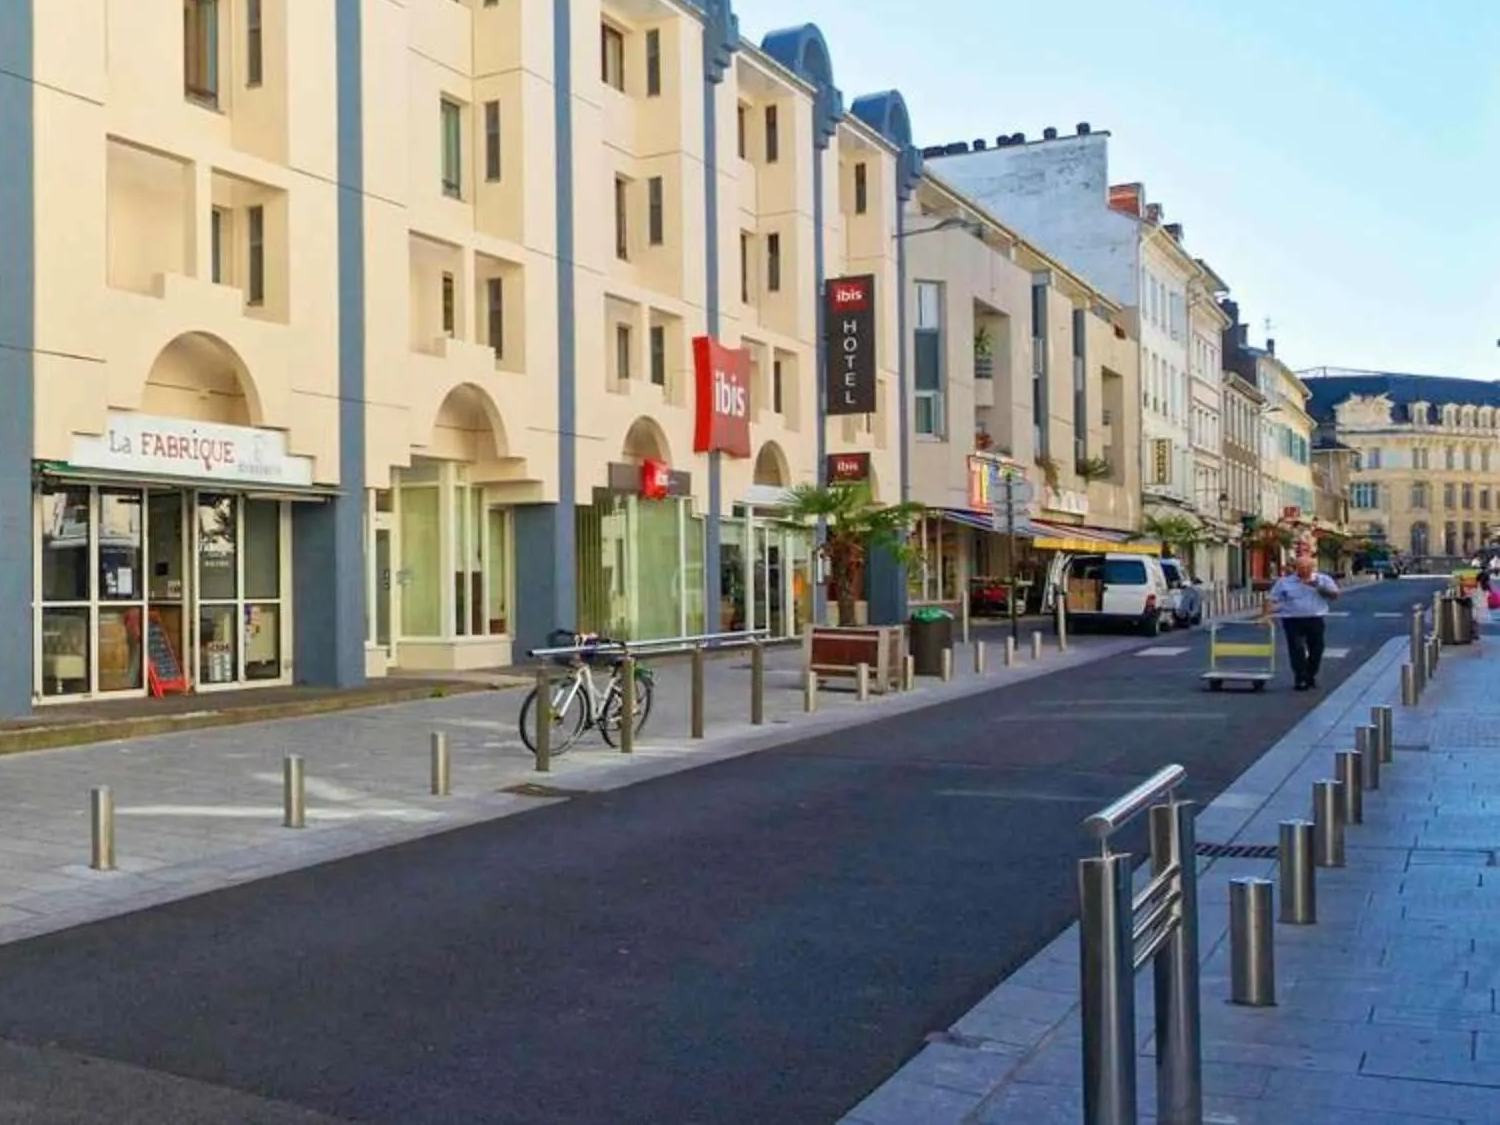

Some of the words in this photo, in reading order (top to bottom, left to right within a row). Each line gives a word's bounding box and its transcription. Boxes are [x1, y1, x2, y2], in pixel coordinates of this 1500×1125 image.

[836, 289, 863, 303] ibis
[843, 320, 858, 405] HOTEL
[715, 369, 746, 417] ibis
[109, 430, 132, 455] La
[837, 460, 859, 472] ibis
